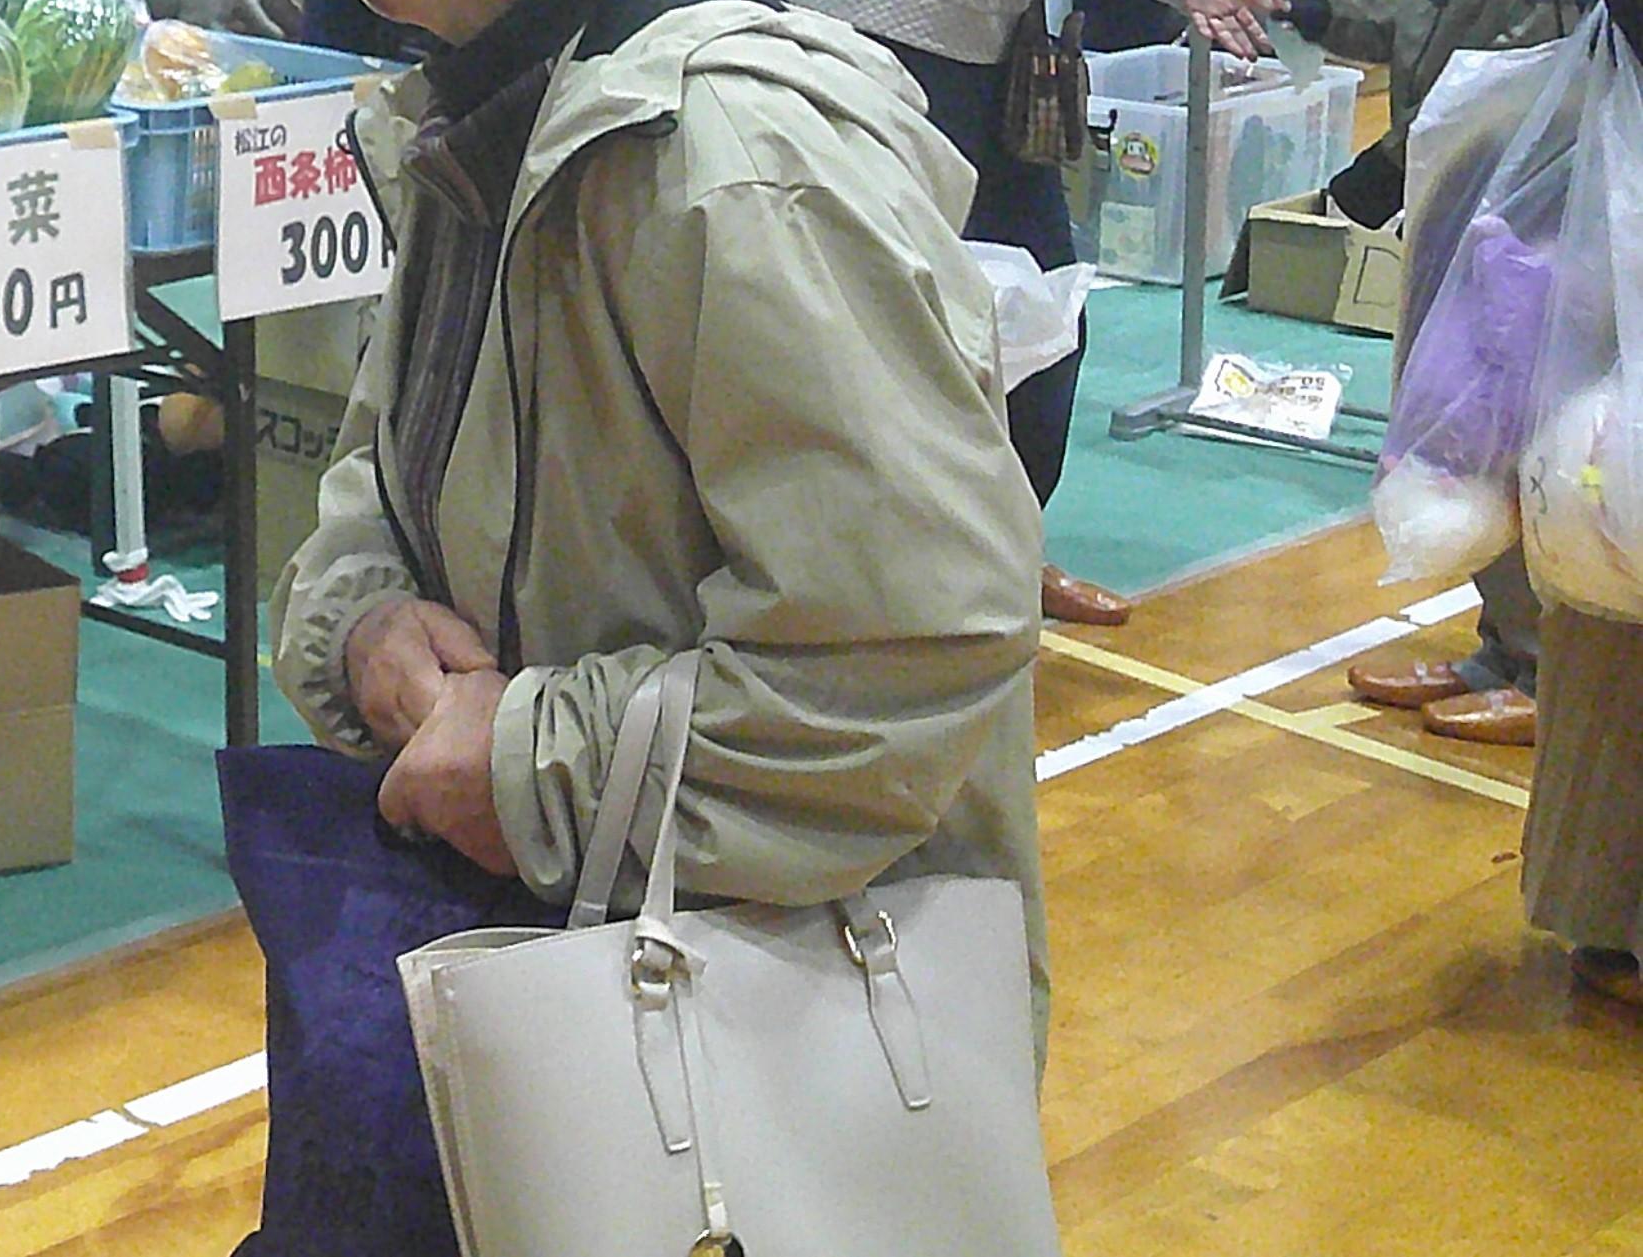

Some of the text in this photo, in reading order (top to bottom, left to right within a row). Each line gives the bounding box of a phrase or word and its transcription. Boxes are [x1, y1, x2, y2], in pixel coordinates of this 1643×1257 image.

[235, 125, 287, 155] 松江の
[280, 211, 390, 285] 300
